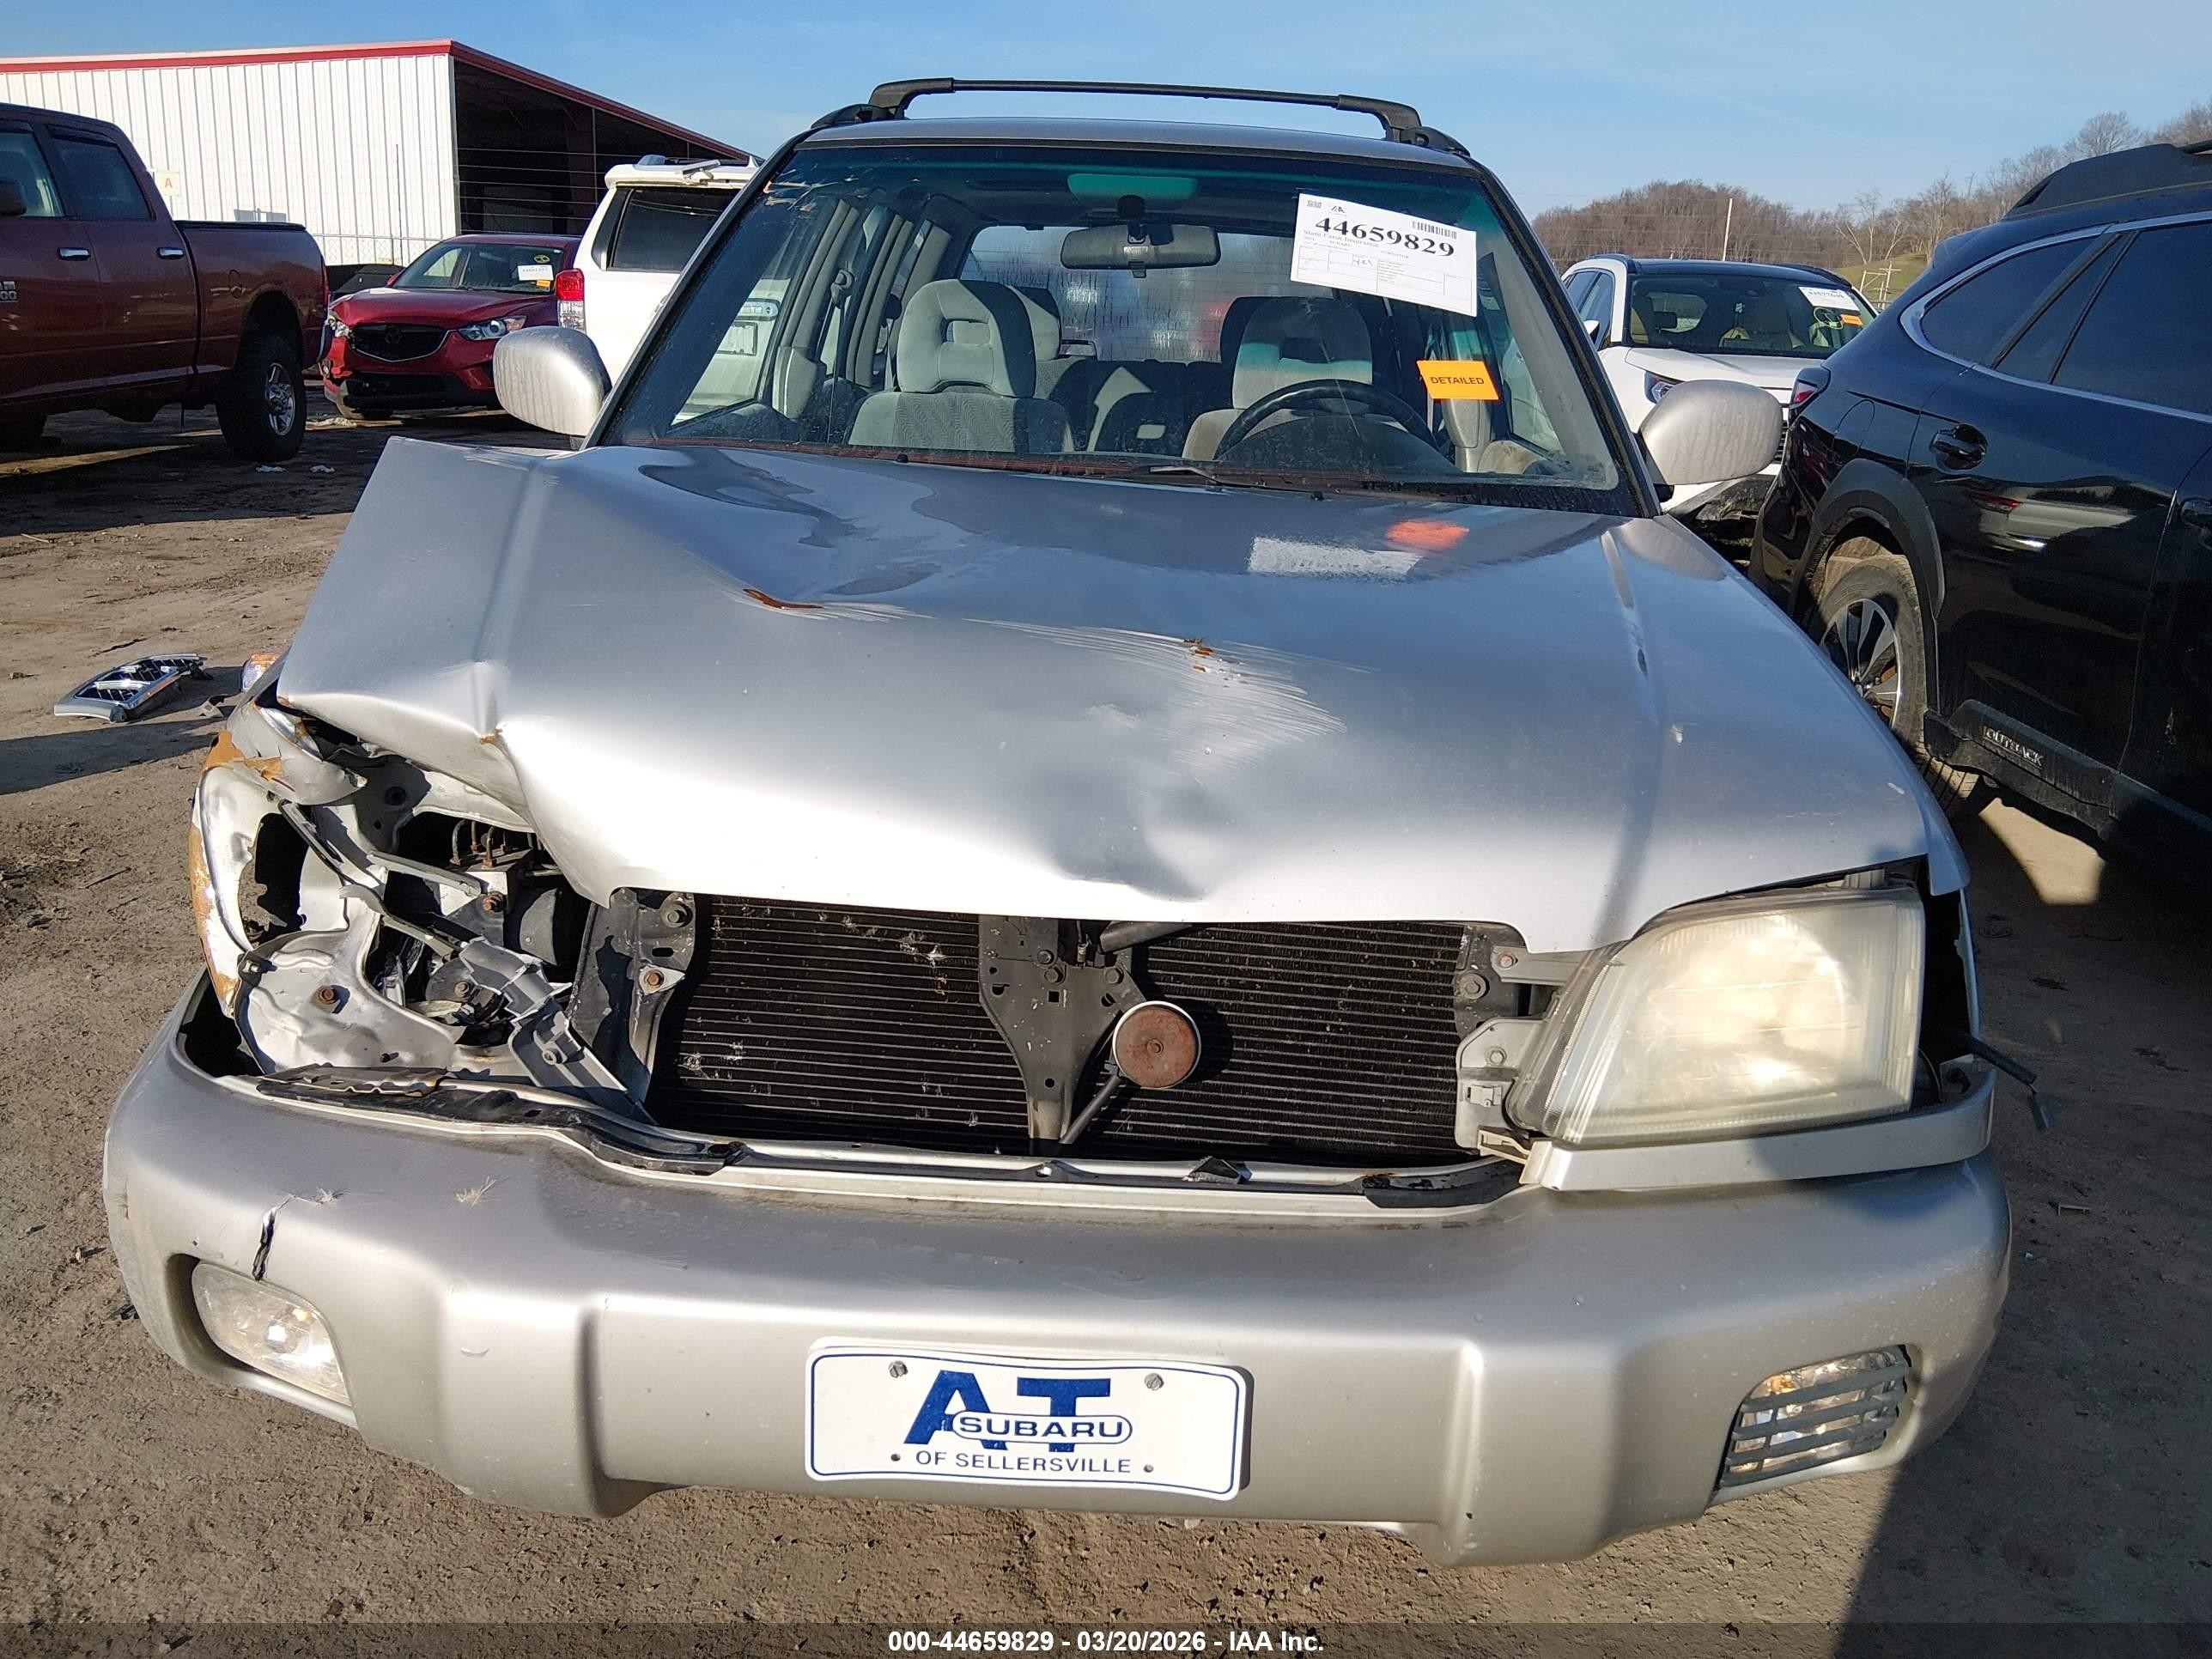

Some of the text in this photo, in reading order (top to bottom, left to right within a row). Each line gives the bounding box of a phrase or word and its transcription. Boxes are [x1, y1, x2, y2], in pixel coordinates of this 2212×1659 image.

[1316, 217, 1455, 257] 44659829
[1986, 727, 2044, 767] OUTBACK
[958, 1416, 1124, 1438] SUBARU
[915, 1449, 1131, 1474] OF SELLERSVILLE
